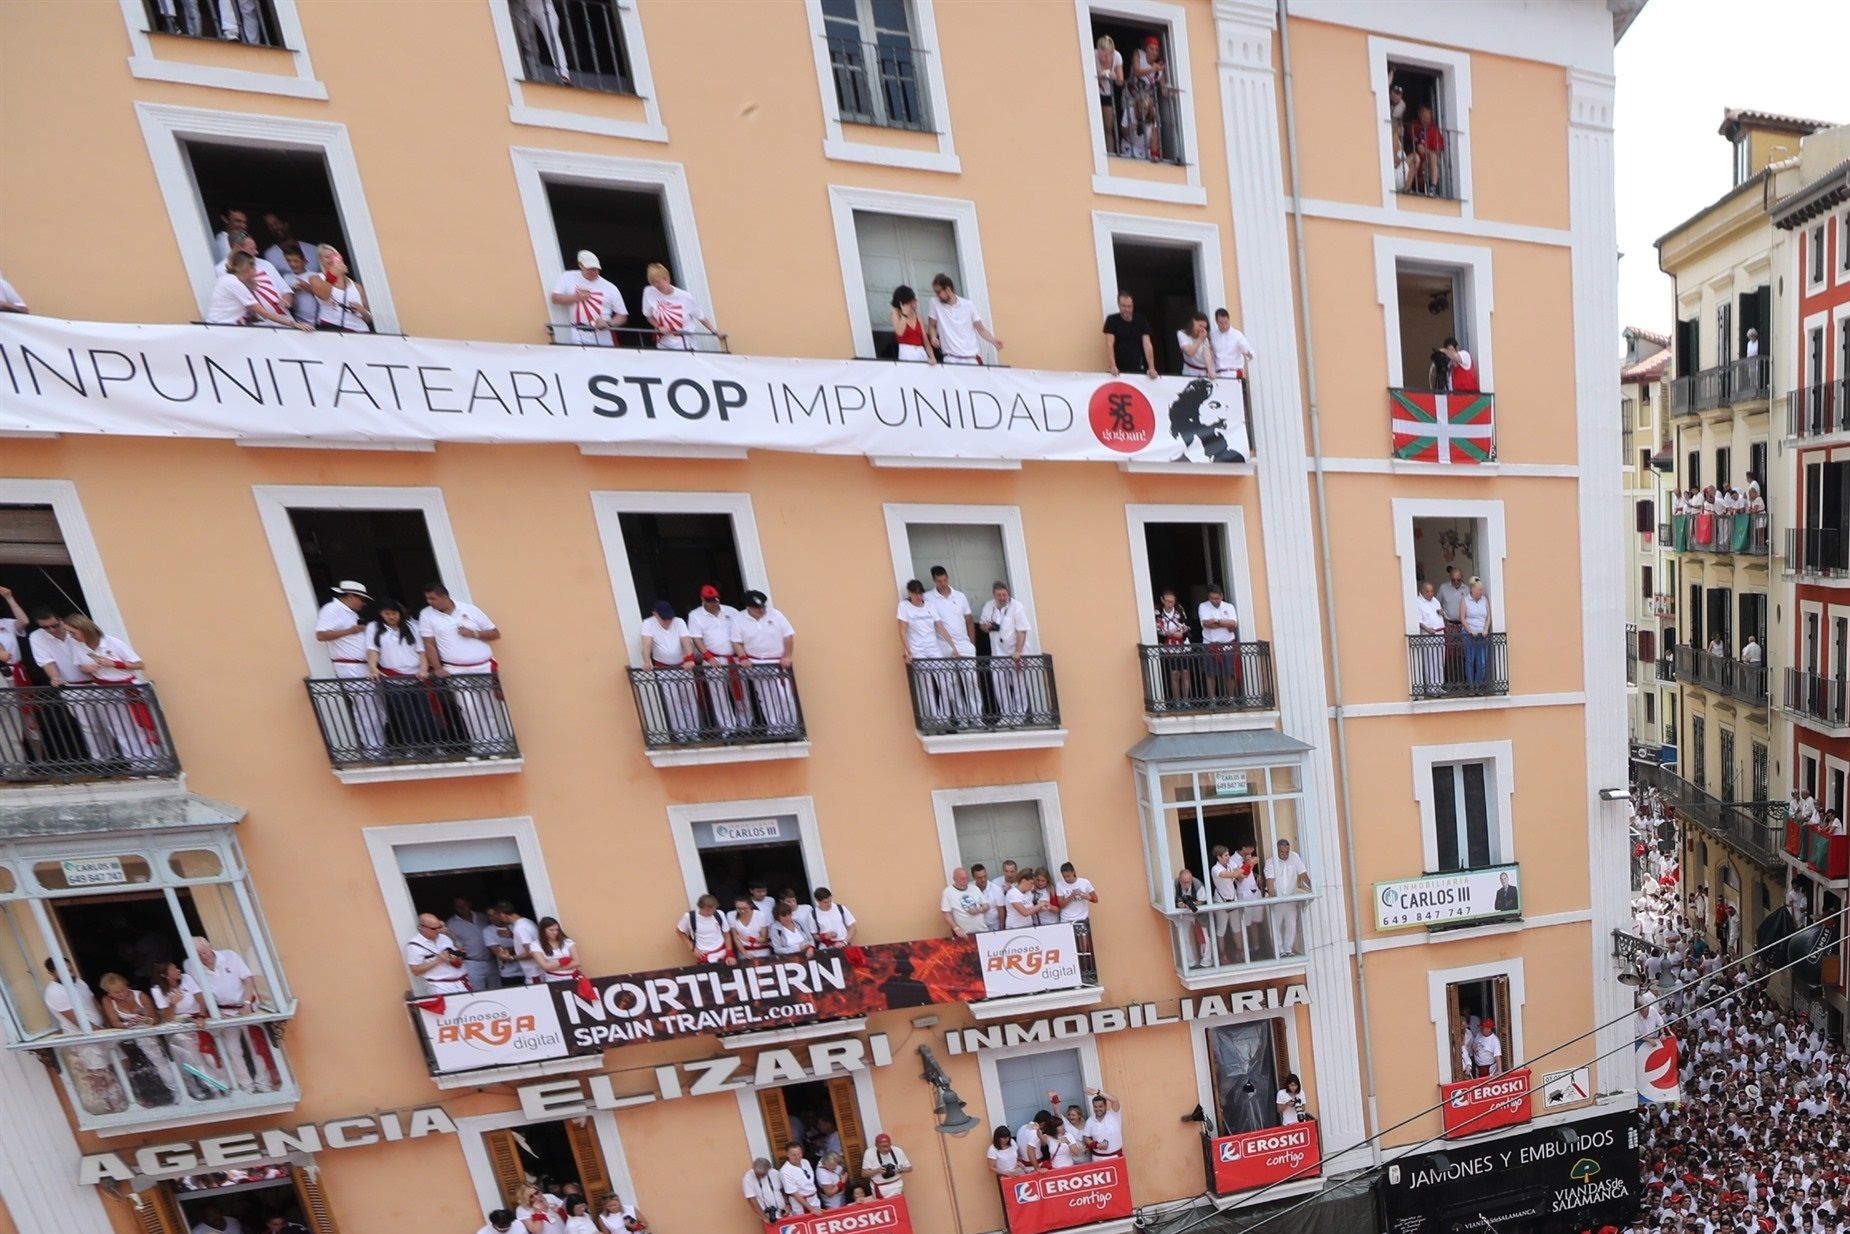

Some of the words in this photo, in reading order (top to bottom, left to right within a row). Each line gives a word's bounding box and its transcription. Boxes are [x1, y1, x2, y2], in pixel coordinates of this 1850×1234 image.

[1, 343, 569, 417] INPUNITATEARI
[587, 376, 749, 421] STOP
[767, 383, 1075, 433] IMPUNIDAD
[728, 826, 766, 840] CARLOS
[766, 825, 778, 837] III
[75, 862, 110, 874] CARLOS
[1399, 877, 1470, 892] INMOBILIARIA
[1401, 887, 1454, 910] CARLOS
[1457, 886, 1470, 903] III
[1383, 915, 1408, 926] 649
[1416, 910, 1441, 922] 847
[1448, 906, 1473, 917] 747
[987, 945, 1040, 958] Luminosos
[987, 948, 1060, 976] ARGA
[1041, 964, 1077, 981] digital
[566, 957, 846, 1024] NORTHERN
[436, 1009, 508, 1028] Luminosos
[574, 1020, 655, 1048] SPAIN
[657, 1001, 816, 1037] TRAVEL.com
[945, 984, 1313, 1056] INMOBILIARIA
[437, 1014, 536, 1046] ARGA
[513, 1031, 560, 1052] digital
[516, 1032, 895, 1120] ELIZARI
[1473, 1080, 1524, 1101] EROSKI
[78, 1108, 459, 1186] AGENCIA
[1246, 1132, 1306, 1155] EROSKI
[1266, 1148, 1304, 1168] contigo
[1499, 1151, 1512, 1168] Y
[1045, 1170, 1113, 1195] EROSKI
[1068, 1187, 1113, 1209] contigo
[1552, 1186, 1629, 1213] SALAMANCA
